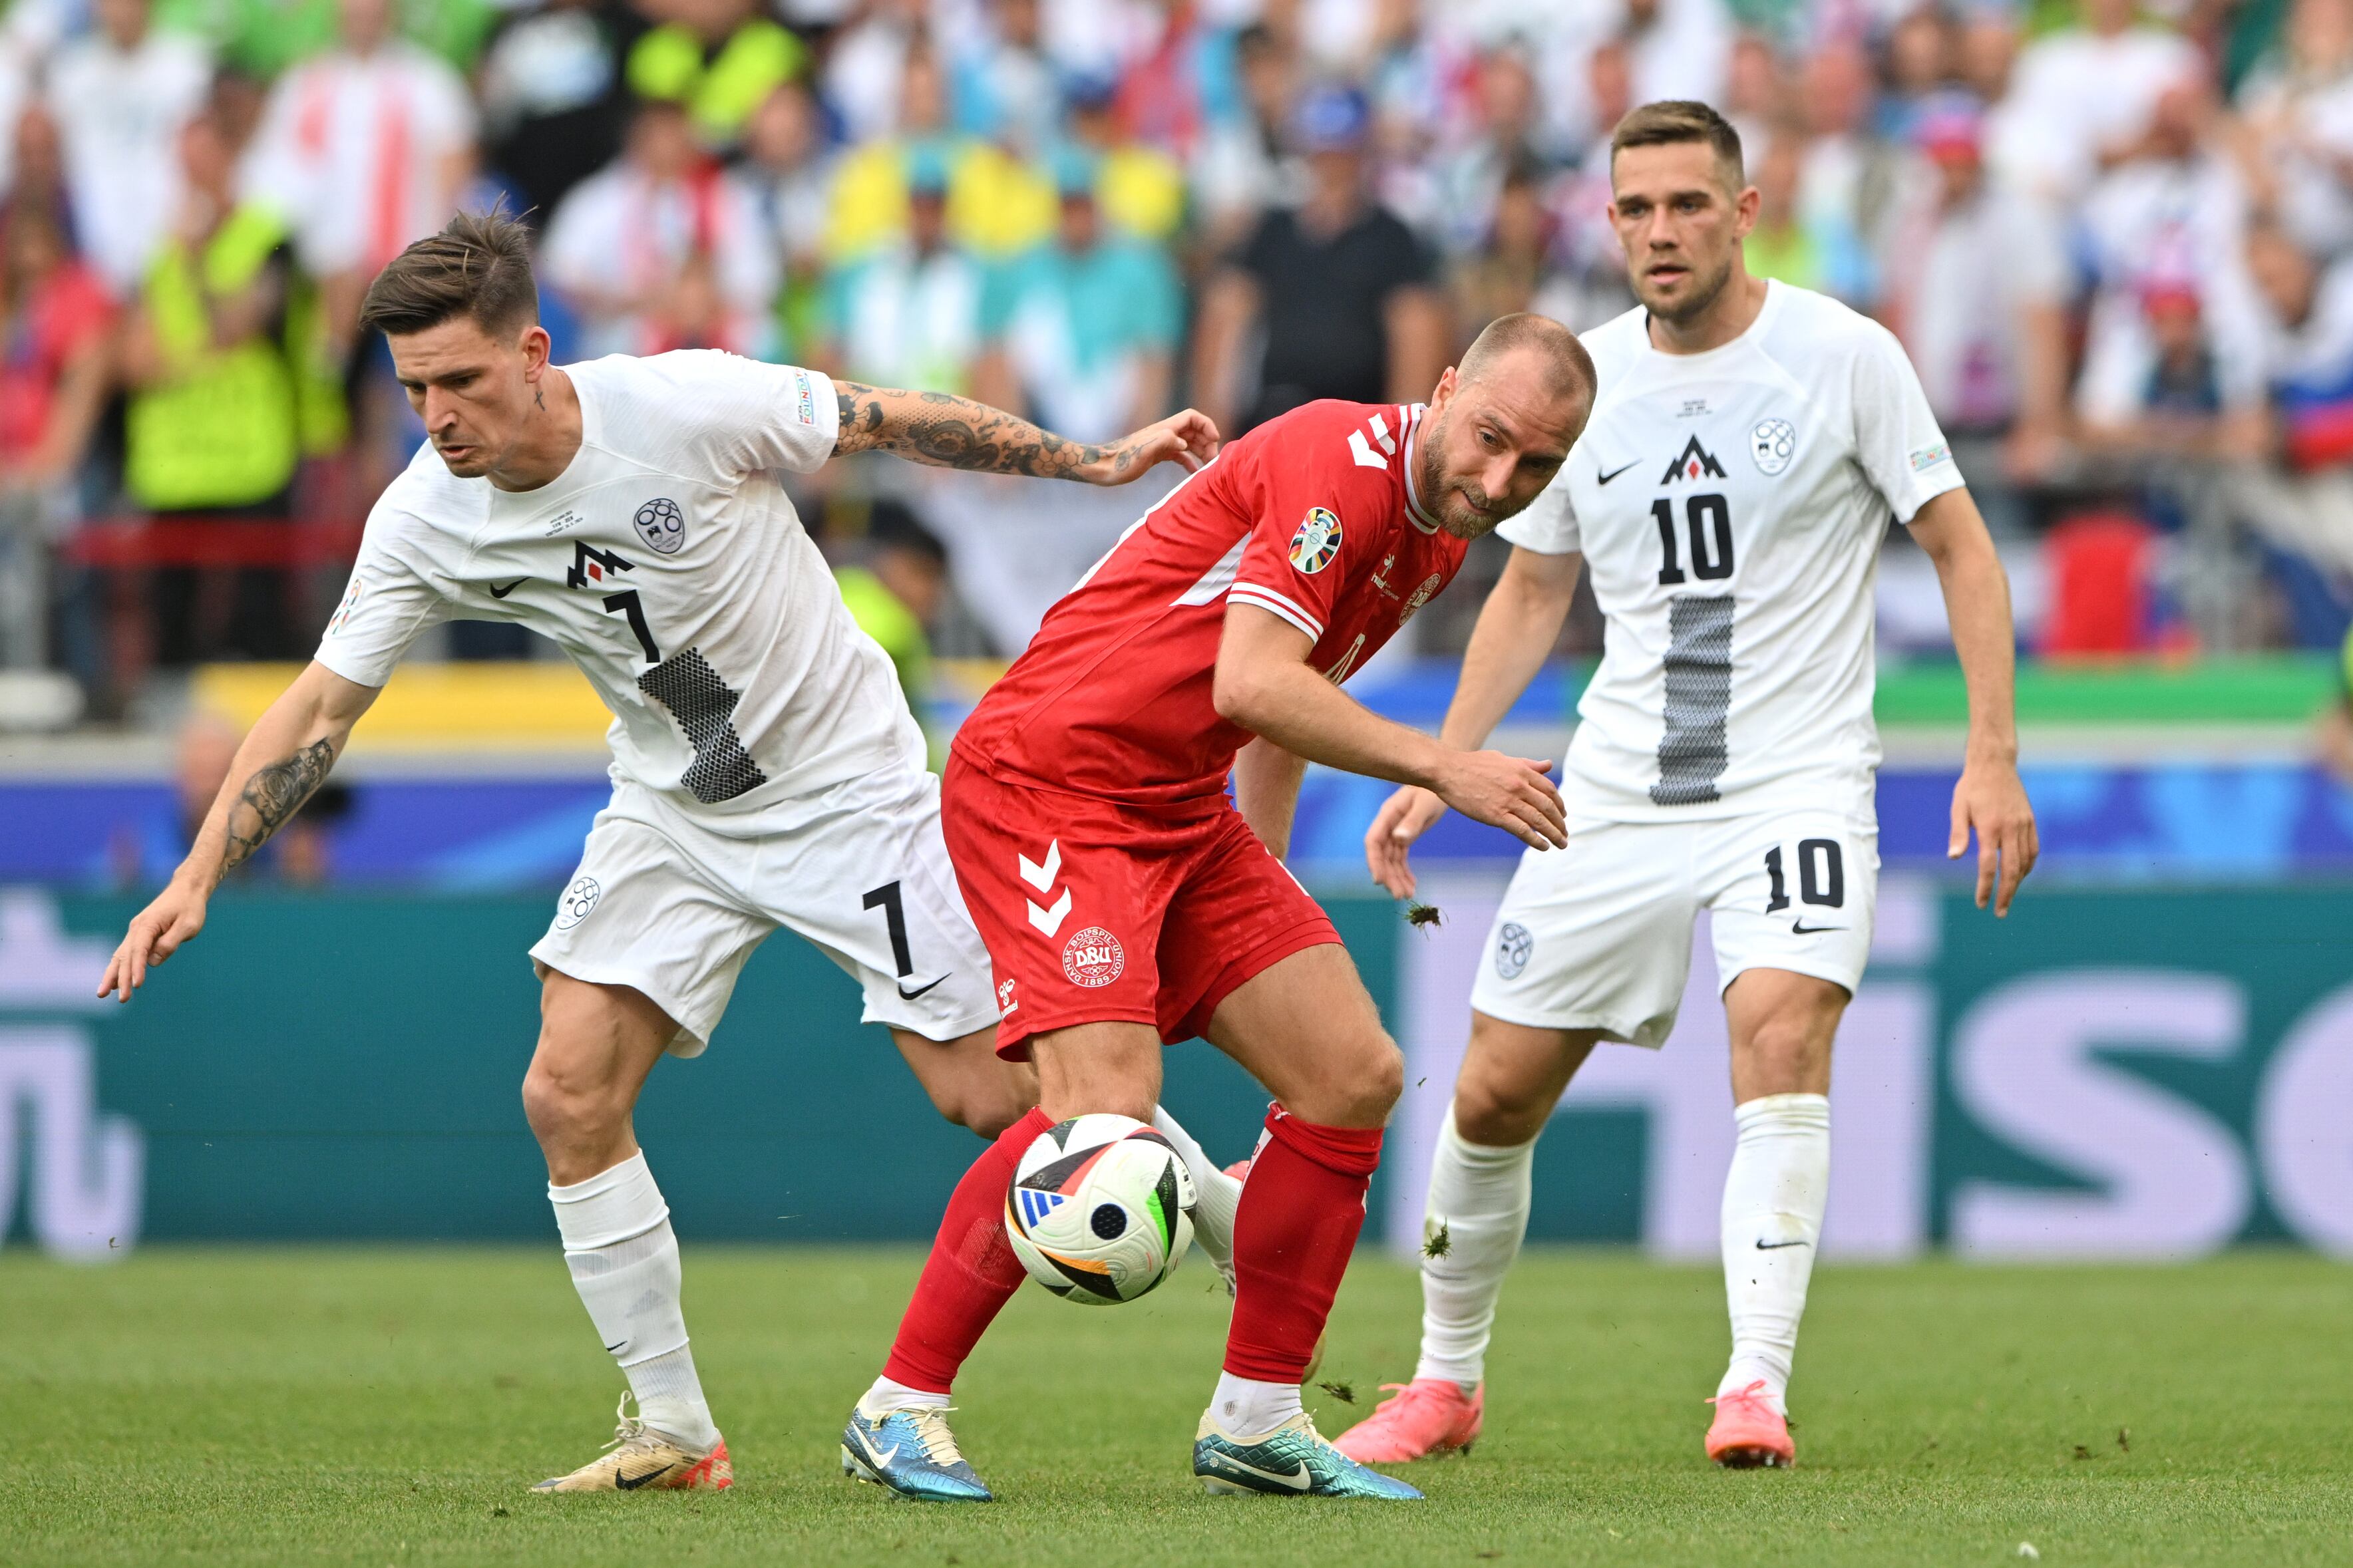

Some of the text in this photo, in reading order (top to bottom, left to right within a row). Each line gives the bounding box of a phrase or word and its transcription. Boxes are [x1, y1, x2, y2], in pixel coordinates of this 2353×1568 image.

[1651, 494, 1734, 585] 10
[1764, 839, 1845, 915] 10
[1065, 949, 1081, 982] DANSK
[1075, 947, 1112, 967] DBU
[1085, 975, 1110, 985] 1889
